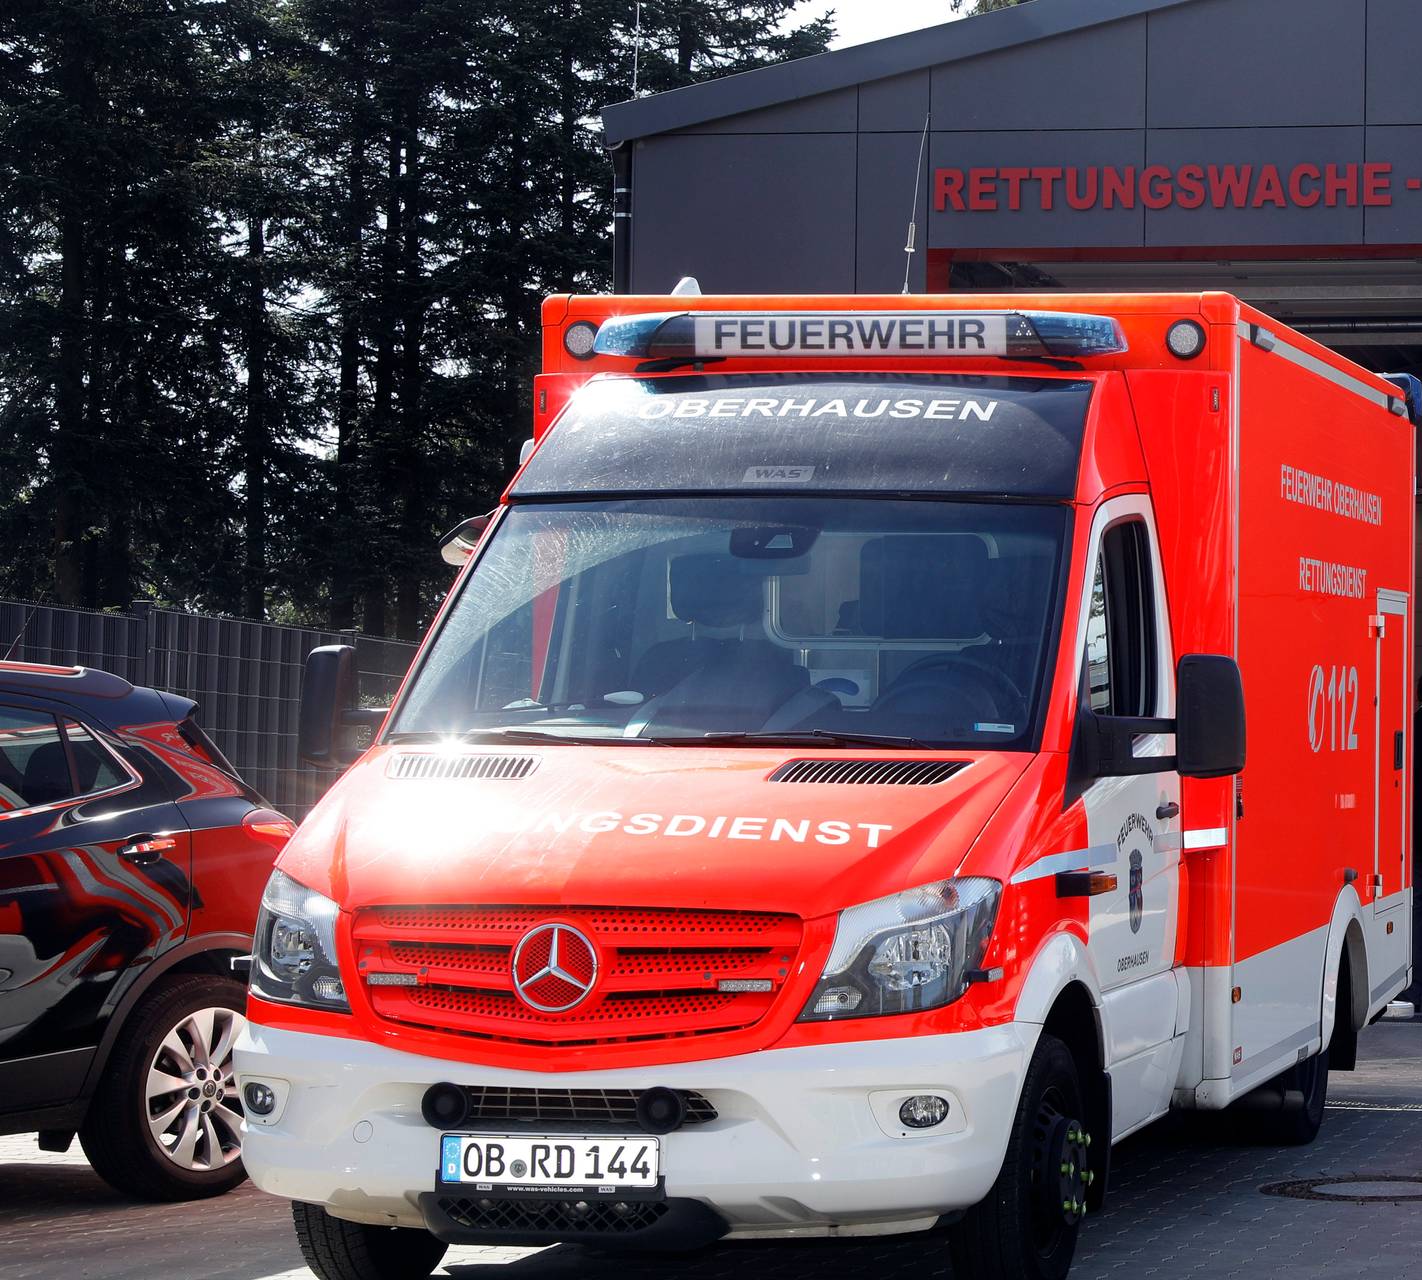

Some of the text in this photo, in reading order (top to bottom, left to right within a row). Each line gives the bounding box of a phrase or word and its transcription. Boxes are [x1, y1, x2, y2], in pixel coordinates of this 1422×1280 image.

[934, 163, 1392, 212] RETTUNGSWACHE
[1407, 178, 1420, 190] -
[714, 319, 986, 351] FEUERWEHR
[638, 398, 998, 422] OBERHAUSEN
[755, 468, 802, 479] WAS
[1280, 463, 1382, 526] FEUERWEHR OBERHAUSEN
[1299, 556, 1367, 599] RETTUNGSDIENST
[1328, 665, 1359, 752] 112
[475, 808, 893, 848] NGSDIENST
[1116, 812, 1154, 852] FEUERWEHR
[1117, 949, 1150, 973] OBERHAUSEN
[463, 1143, 505, 1178] OB
[531, 1144, 575, 1179] RD
[585, 1145, 650, 1179] 144
[507, 1185, 584, 1193] www.was-vehicles.com
